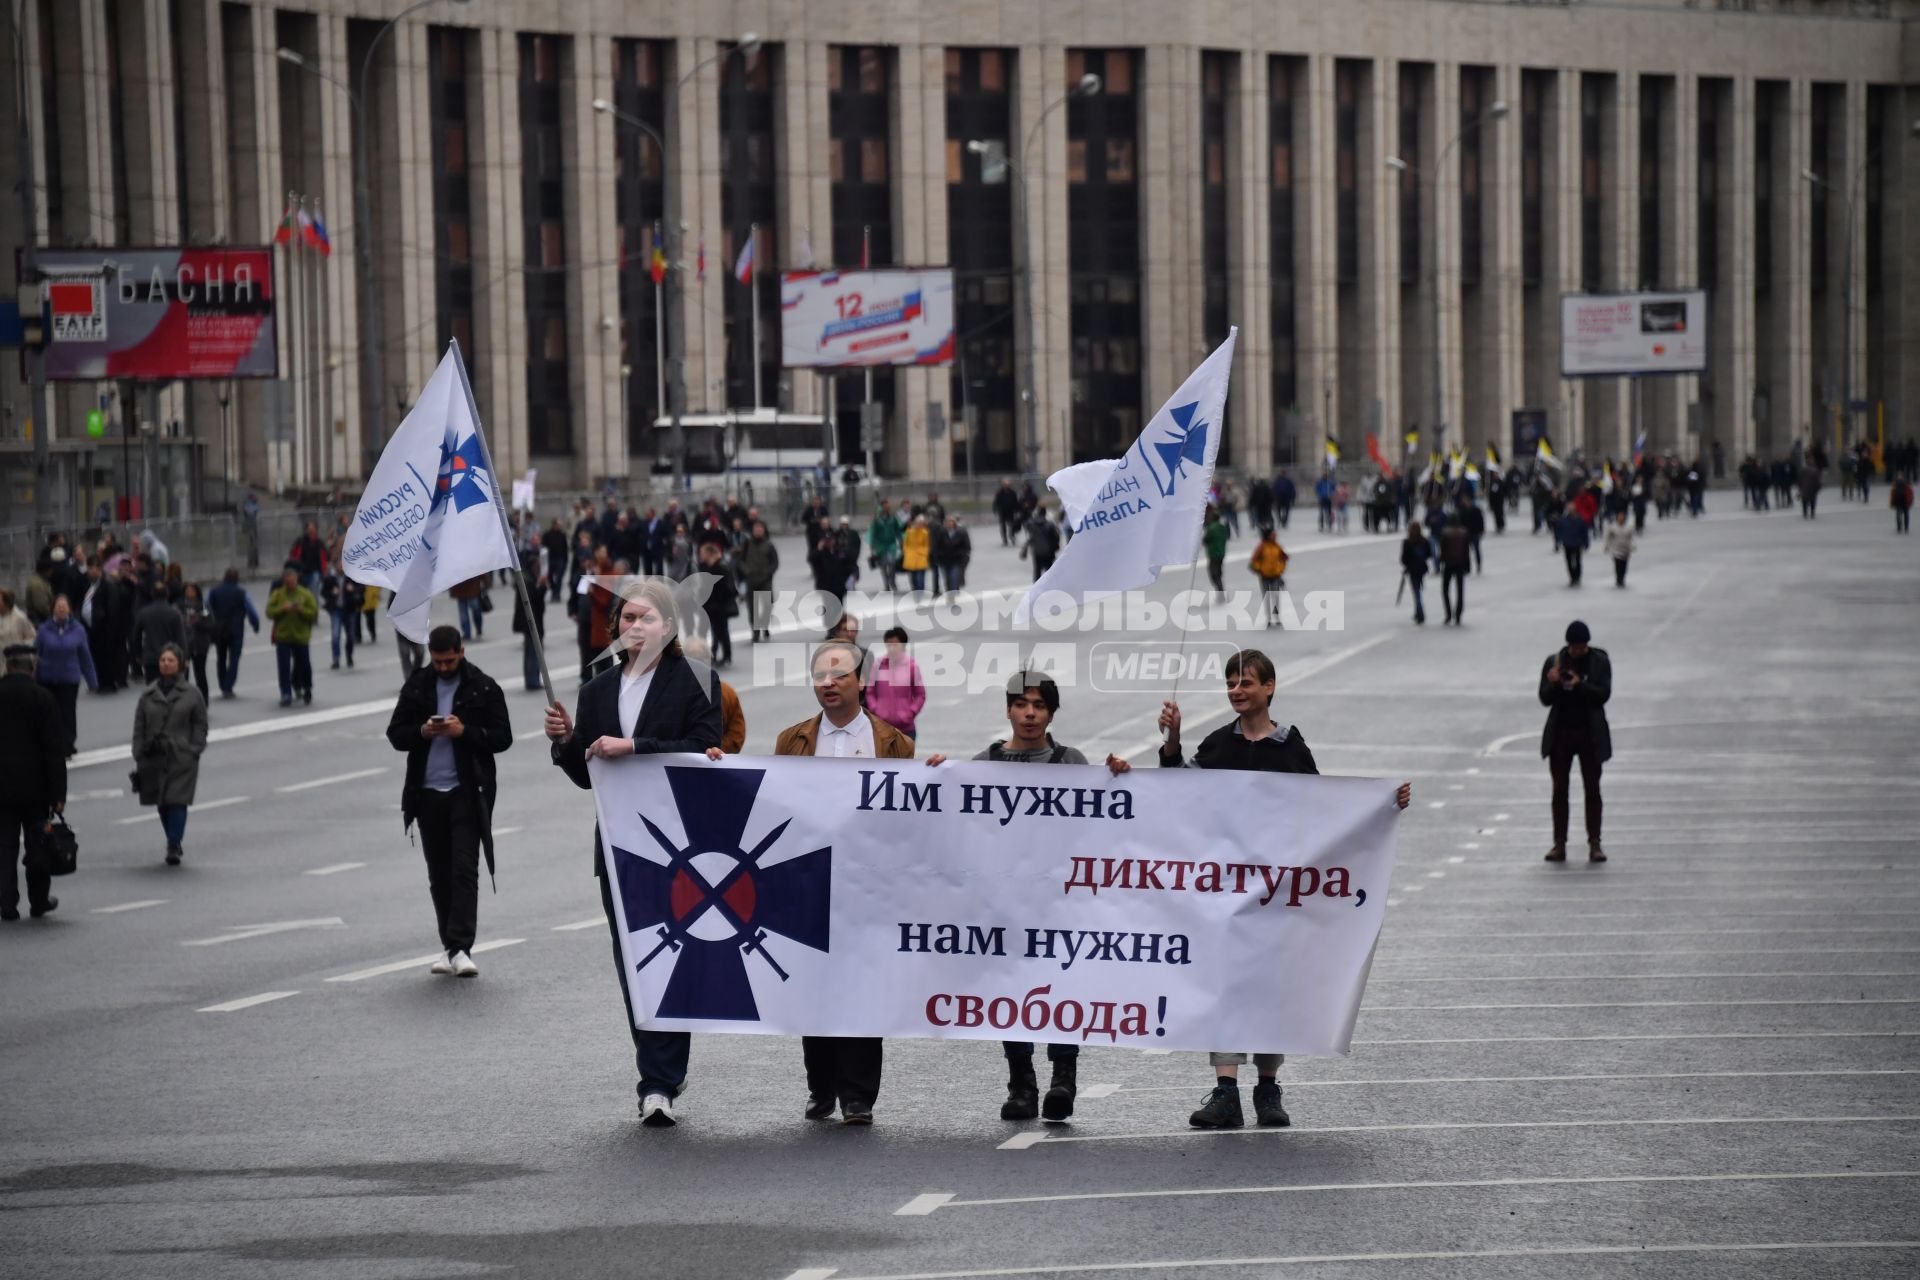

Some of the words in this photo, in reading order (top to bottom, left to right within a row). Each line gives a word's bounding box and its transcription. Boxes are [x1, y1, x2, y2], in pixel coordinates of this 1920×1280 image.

[118, 262, 253, 304] БАСНЯ
[835, 292, 864, 320] 12
[54, 317, 101, 331] ЕАТР
[856, 770, 942, 812] Им
[960, 785, 1135, 826] нужна
[1064, 856, 1367, 908] диктатура,
[897, 922, 1006, 956] нам
[1024, 928, 1192, 971] нужна
[926, 984, 1167, 1041] свобода!
